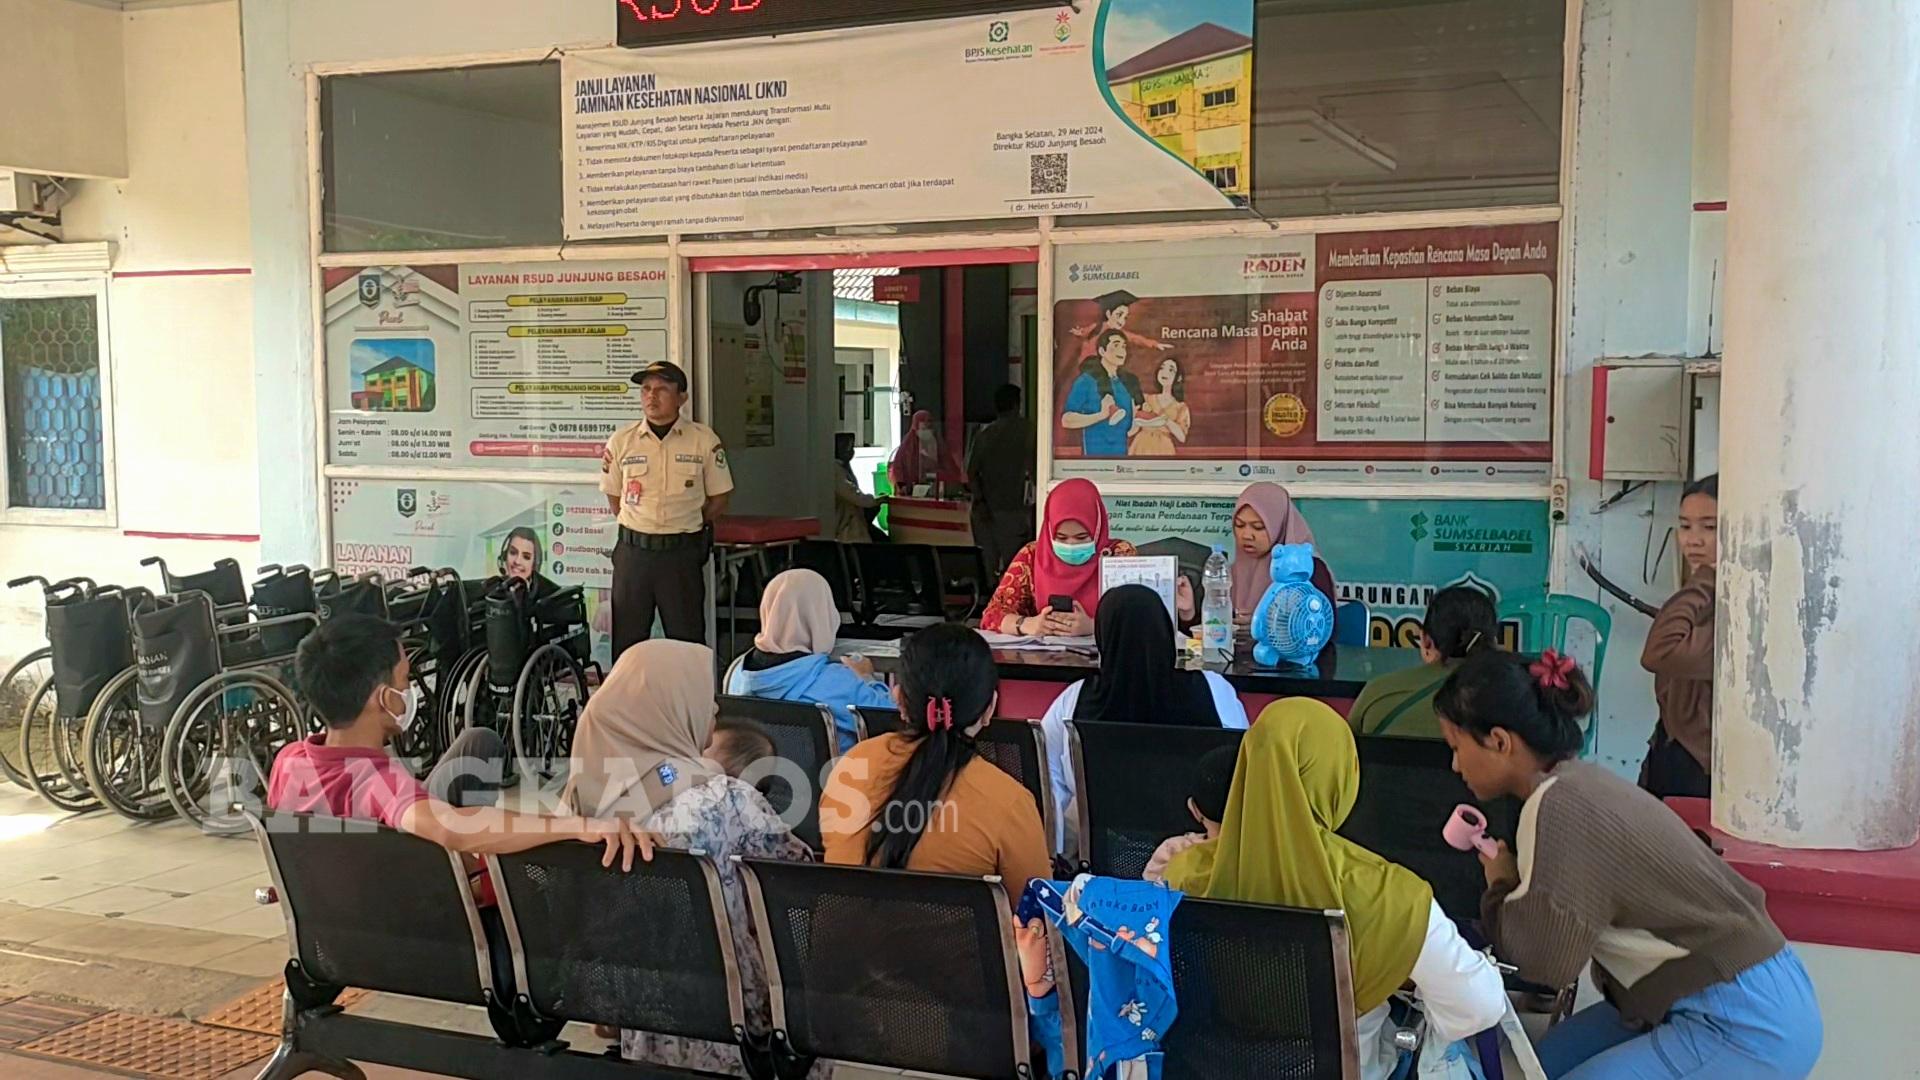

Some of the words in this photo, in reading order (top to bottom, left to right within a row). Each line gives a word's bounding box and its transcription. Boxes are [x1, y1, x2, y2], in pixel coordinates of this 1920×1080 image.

[965, 48, 985, 58] BPJS
[986, 44, 1033, 56] Kesehatan
[575, 78, 602, 97] JANJI
[606, 74, 656, 94] LAYANAN
[576, 96, 624, 114] JAMINAN
[627, 89, 692, 110] KESEHATAN
[695, 83, 753, 105] NASIONAL
[613, 118, 628, 127] RSUD
[631, 116, 654, 127] Junjung
[680, 112, 703, 122] beserta
[706, 110, 729, 122] Jajaran
[731, 107, 768, 120] mendukung
[770, 104, 811, 115] Transformasi
[576, 129, 601, 141] Layanan
[603, 129, 617, 139] yang
[665, 123, 676, 132] dan
[678, 121, 699, 131] Setara
[701, 119, 723, 131] kepada
[725, 117, 749, 127] Peserta
[752, 116, 764, 125] JKN
[997, 130, 1023, 142] Bangka
[1058, 127, 1067, 137] 29
[1069, 126, 1082, 136] Mei
[1085, 125, 1103, 135] 2024
[699, 133, 739, 145] pendaftaran
[740, 131, 774, 143] pelayanan
[994, 140, 1024, 151] Direktur
[1026, 138, 1045, 149] RSUD
[1047, 136, 1078, 150] Junjung
[633, 152, 661, 162] dokumen
[690, 149, 713, 160] kepada
[715, 147, 738, 157] Peserta
[740, 145, 765, 157] sebagai
[788, 141, 830, 153] pendaftaran
[832, 138, 867, 150] pelayanan
[625, 166, 657, 178] pelayanan
[695, 161, 728, 171] tambahan
[751, 158, 785, 168] ketentuan
[712, 176, 732, 185] Pasien
[675, 194, 690, 203] yang
[691, 190, 728, 200] dibutuhkan
[729, 189, 741, 198] dan
[743, 188, 758, 197] tidak
[760, 185, 810, 196] membebankan
[811, 184, 837, 193] Peserta
[839, 183, 858, 192] untuk
[859, 181, 888, 190] mencari
[890, 180, 906, 189] obat
[908, 179, 922, 190] jika
[923, 177, 954, 189] terdapat
[1028, 201, 1050, 211] Helen
[1051, 199, 1082, 212] Sukendy
[616, 218, 639, 227] Peserta
[641, 217, 664, 228] dengan
[686, 215, 704, 226] tanpa
[705, 213, 744, 223] diskriminasi
[1329, 248, 1380, 268] Memberikan
[1383, 246, 1424, 268] Kepastian
[1427, 244, 1463, 264] Rencana
[1467, 243, 1489, 262] Masa
[1492, 241, 1520, 264] Depan
[1523, 240, 1546, 260] Anda
[1082, 263, 1103, 273] BANK
[468, 274, 519, 285] LAYANAN
[523, 273, 554, 284] RSUD
[557, 272, 613, 282] JUNJUNG
[1082, 271, 1140, 281] SUMSELBABEL
[1251, 309, 1308, 323] Sahabat
[1162, 326, 1217, 340] Rencana
[1222, 325, 1258, 338] Masa
[1263, 324, 1307, 340] Depan
[1271, 338, 1308, 352] Anda
[600, 424, 616, 435] 1754
[1115, 500, 1130, 508] Niat
[1132, 500, 1158, 508] Ibadah
[1160, 500, 1175, 510] Haji
[1176, 500, 1198, 508] Lebih
[1125, 511, 1156, 519] Sarana
[1158, 511, 1208, 521] Pendanaan
[1434, 514, 1470, 527] BANK
[1434, 528, 1533, 542] SUMSELBABEL
[336, 543, 412, 564] LAYANAN
[1455, 543, 1512, 552] SYARIAH
[1336, 584, 1434, 606] ABUNGAN
